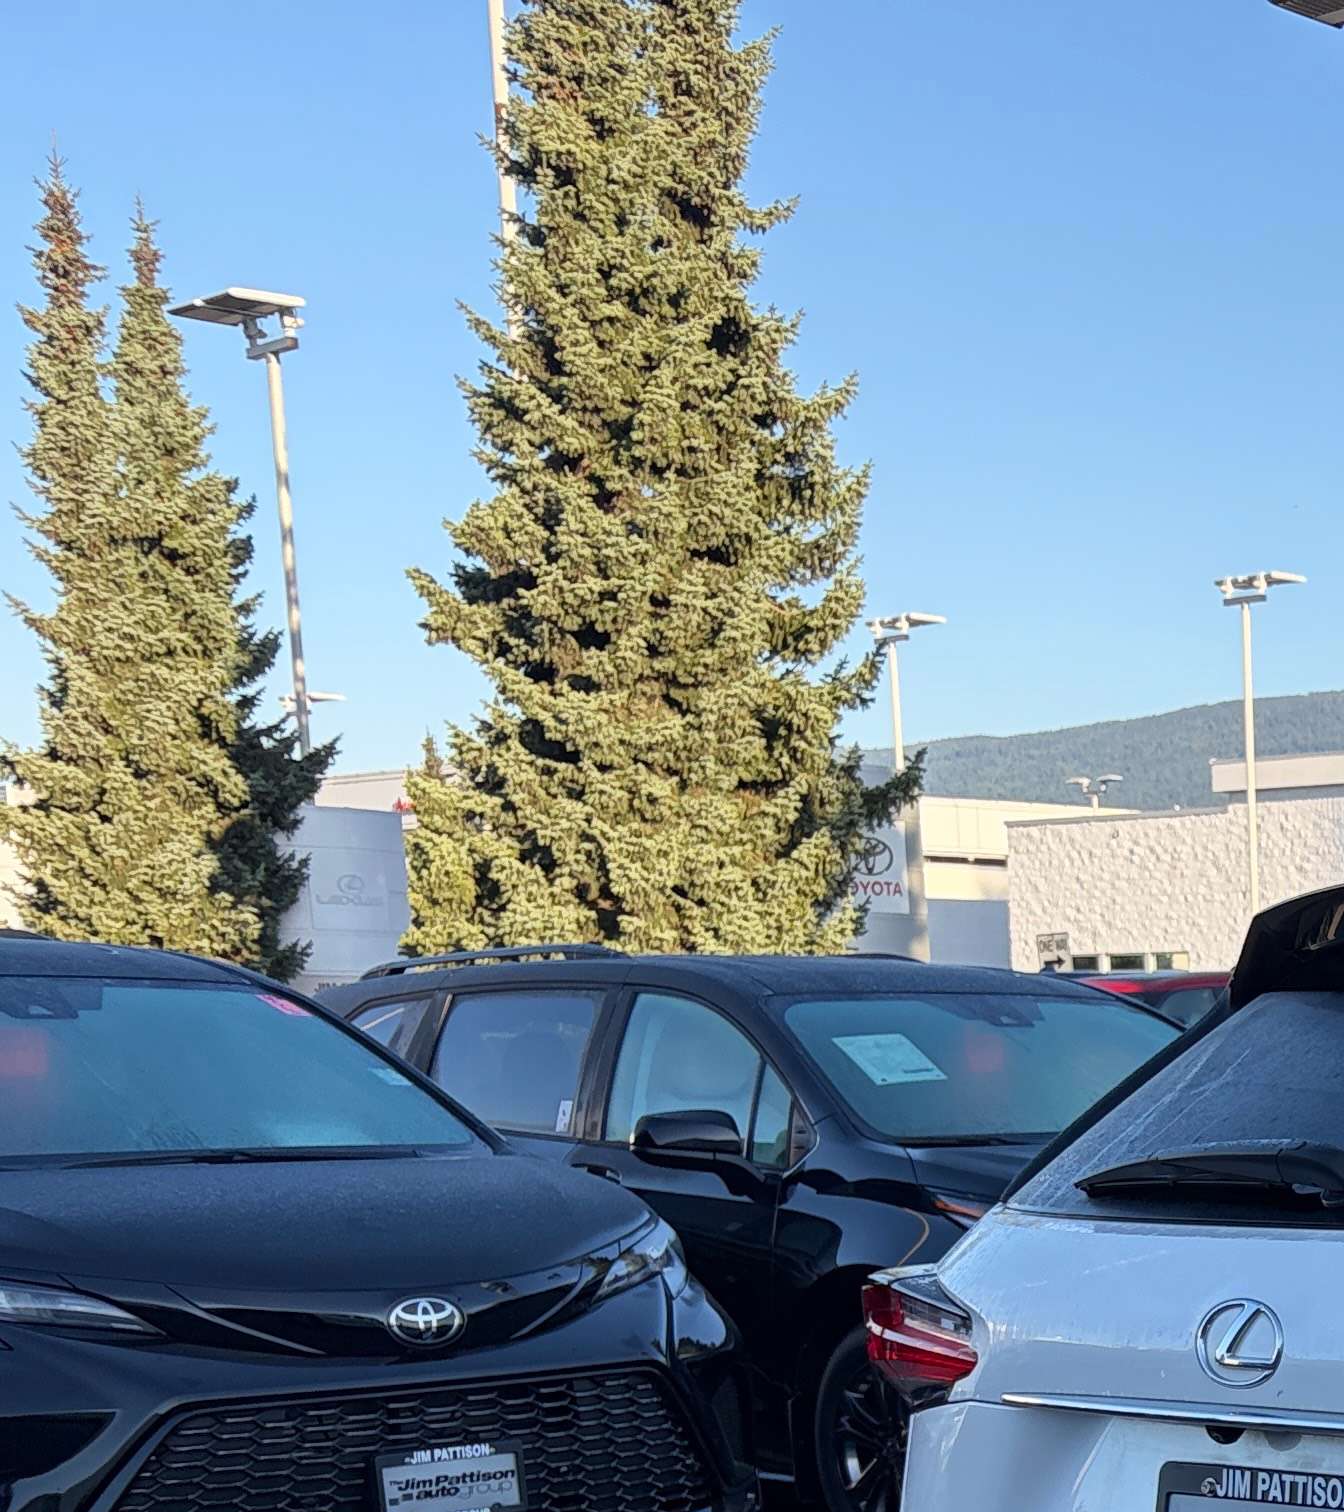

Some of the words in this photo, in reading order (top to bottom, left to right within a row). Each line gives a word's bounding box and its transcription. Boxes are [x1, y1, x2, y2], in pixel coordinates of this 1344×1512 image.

[849, 880, 904, 896] OYOTA
[410, 1449, 431, 1464] JIM
[433, 1443, 490, 1462] PATTISON
[1216, 1468, 1250, 1499] JIM
